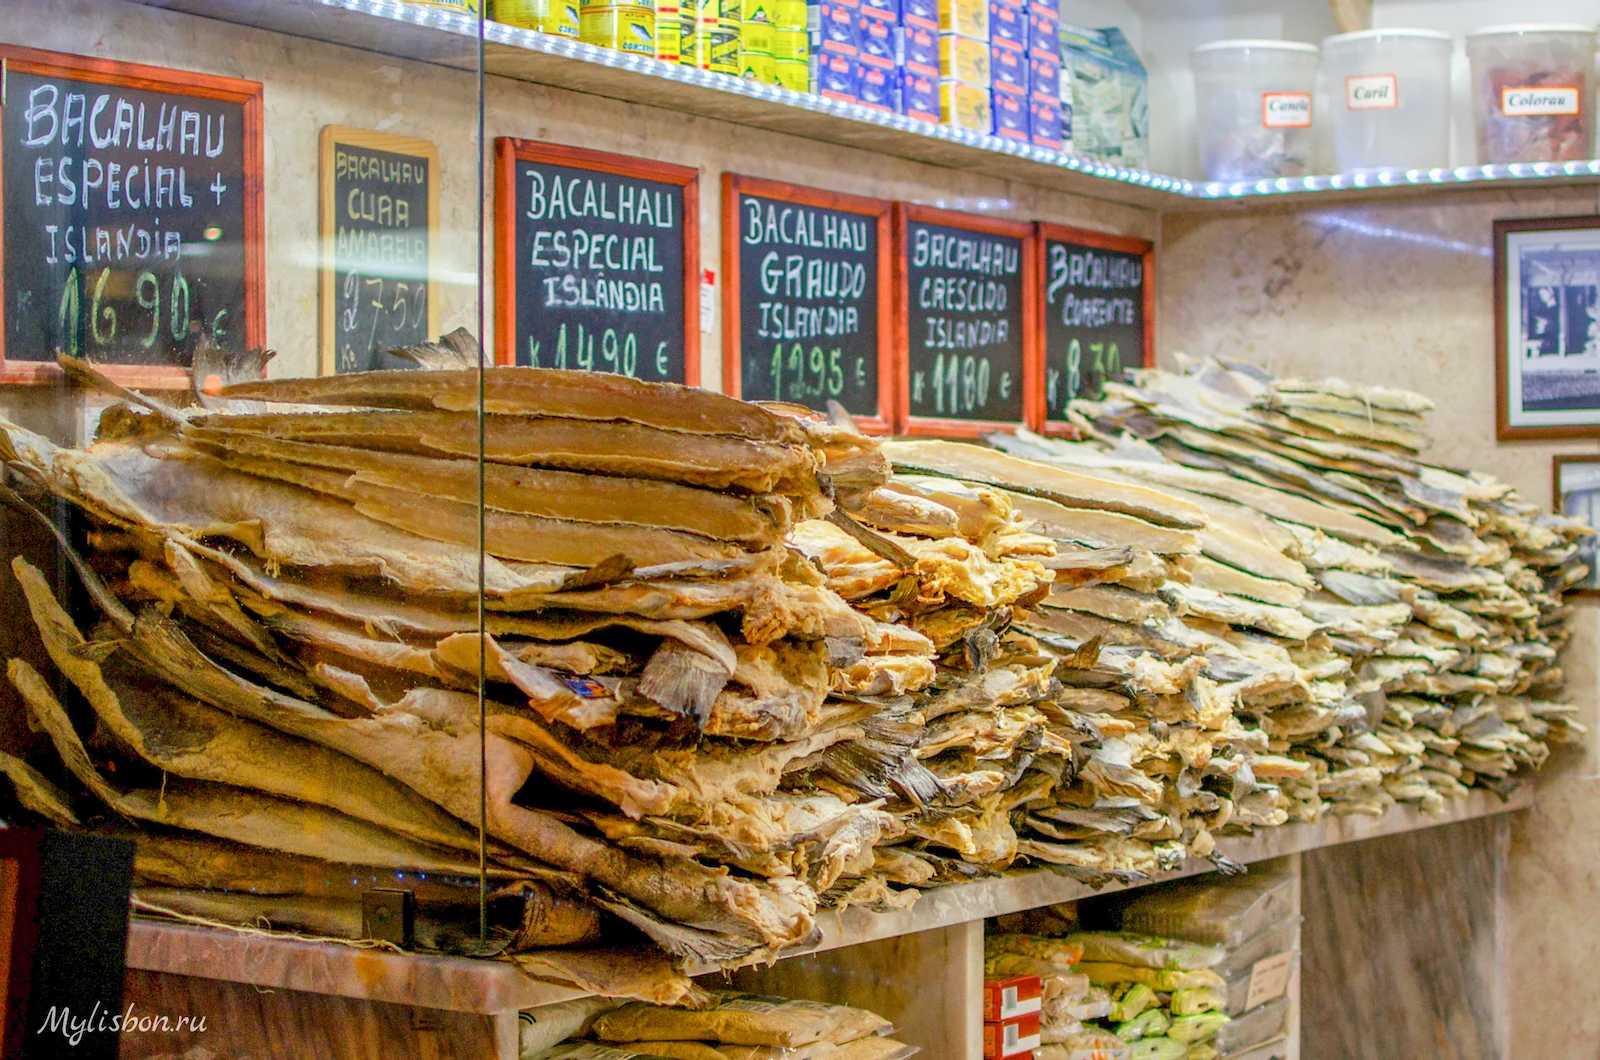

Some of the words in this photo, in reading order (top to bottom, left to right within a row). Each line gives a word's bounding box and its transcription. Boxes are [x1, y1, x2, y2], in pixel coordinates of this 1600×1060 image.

[1354, 84, 1389, 100] Caril
[1509, 92, 1567, 107] Colorau
[21, 84, 225, 157] BACALHAU
[35, 156, 193, 209] ESPECIAL
[210, 172, 227, 206] +
[336, 151, 424, 184] BACALHAU
[526, 170, 673, 228] BACALHAU
[45, 217, 181, 264] ISLANDIA
[744, 198, 867, 251] BACALHAU
[531, 228, 663, 272] ESPECIAL
[913, 229, 1018, 276] BACALHAU
[760, 251, 867, 300] GRAUDO
[919, 277, 1008, 312] CRESCIDO
[1047, 244, 1142, 304] BACALHAU
[758, 299, 859, 339] ISLANDIA
[924, 313, 1009, 349] ISLANDIA
[656, 341, 669, 376] €
[1000, 372, 1012, 398] €
